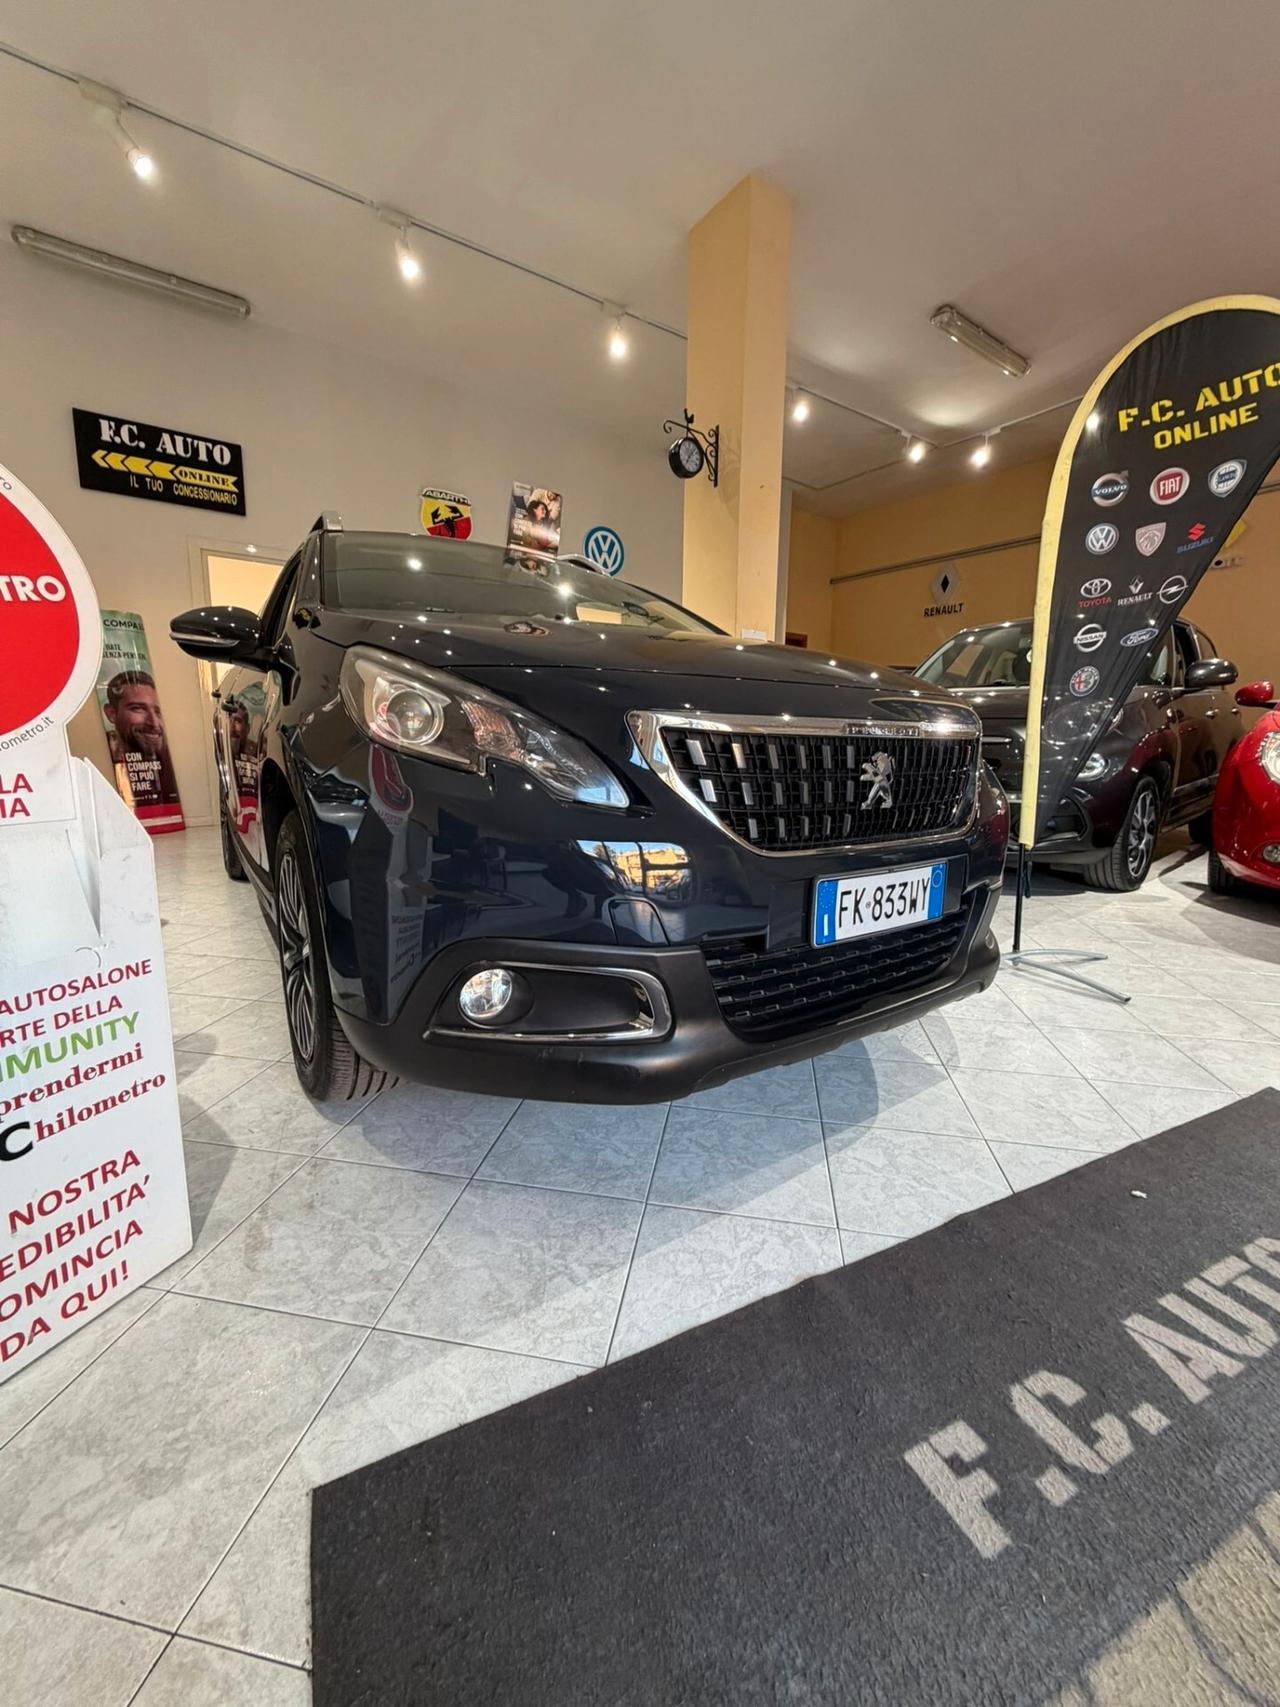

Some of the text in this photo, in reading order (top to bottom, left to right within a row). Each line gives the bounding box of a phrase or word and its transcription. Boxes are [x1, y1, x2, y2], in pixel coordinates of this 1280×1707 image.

[1118, 362, 1280, 433] F.C. AUTO
[1153, 402, 1259, 449] ONLINE
[98, 418, 232, 466] F.C. AUTO
[178, 467, 230, 487] ONLINE
[1159, 476, 1181, 496] FIAT
[129, 474, 238, 506] IL TUO CONCESSIONARIO
[426, 490, 469, 505] ABARTH
[1094, 484, 1128, 495] VOLVO
[1078, 597, 1112, 608] TOYOTA
[1117, 592, 1153, 606] RENAULT
[923, 602, 964, 617] RENAULT
[1076, 633, 1105, 643] NISSAN
[0, 716, 54, 751] ometro.it
[125, 752, 142, 762] CON
[127, 761, 162, 771] COMPASS
[129, 773, 139, 782] SI
[131, 781, 152, 791] FARE
[53, 995, 123, 1030] DELLA
[0, 1011, 139, 1083] MUNITY
[8, 1149, 141, 1234] NOSTRA
[0, 1219, 143, 1323] OMINCIA
[0, 1259, 129, 1362] DA QUI!
[903, 1369, 1172, 1560] F.C.
